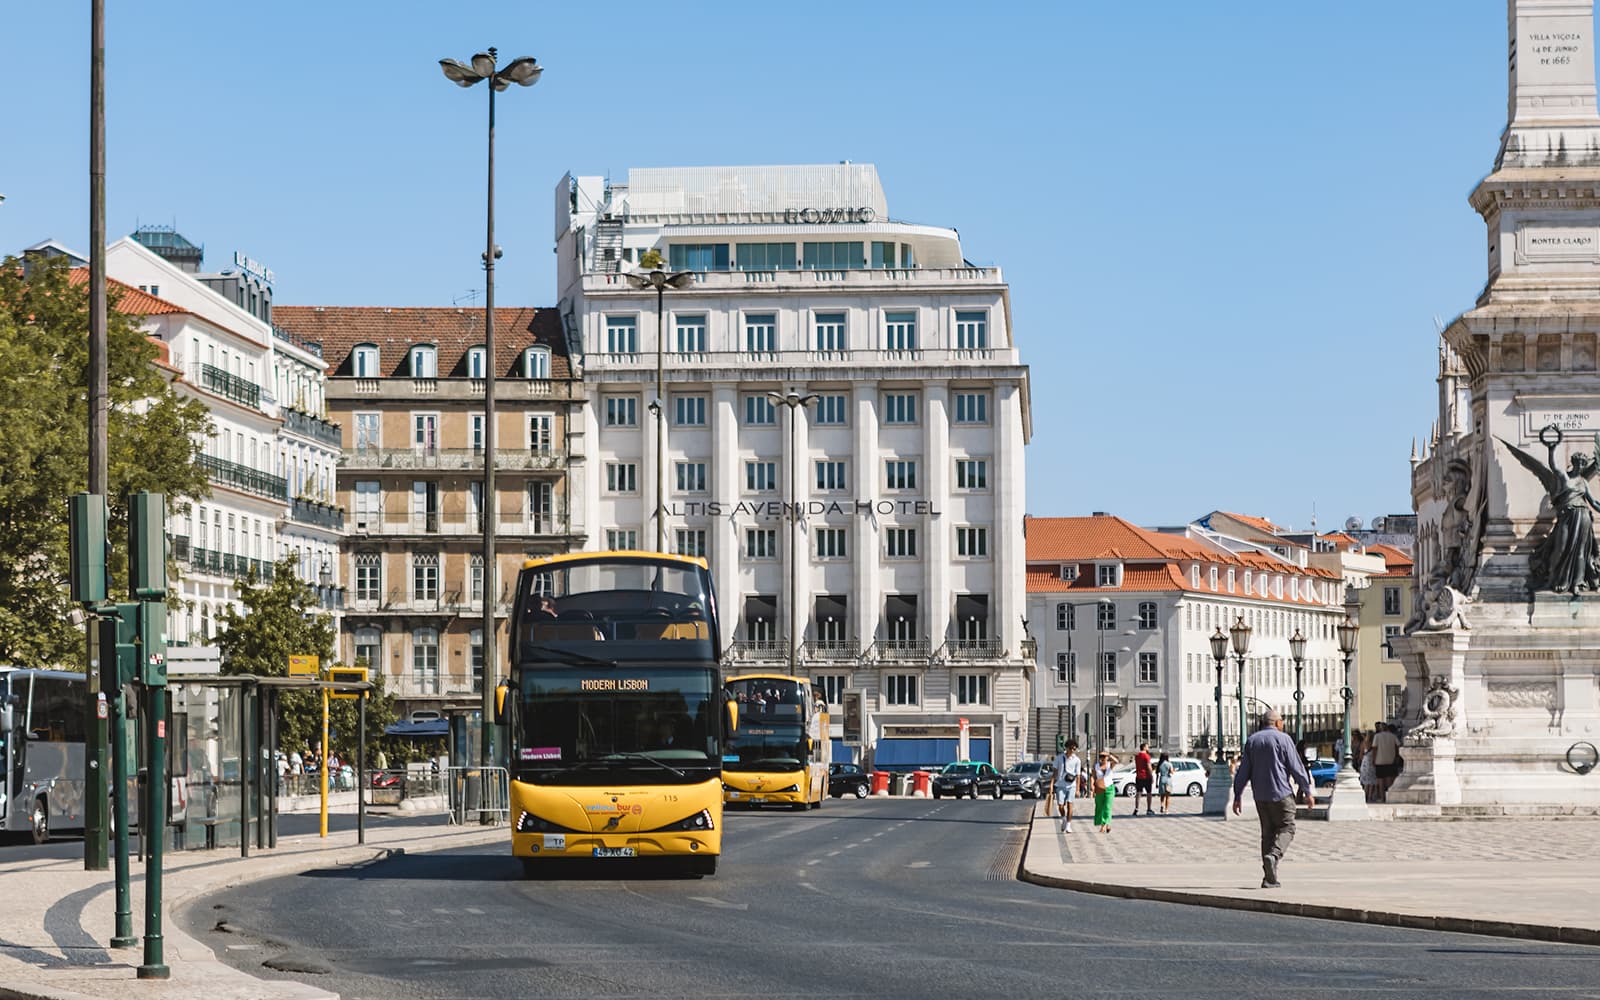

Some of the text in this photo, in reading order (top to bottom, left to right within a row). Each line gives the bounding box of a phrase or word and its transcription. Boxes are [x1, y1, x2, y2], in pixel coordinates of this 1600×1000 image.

[731, 501, 844, 516] AVENIDA
[855, 500, 942, 515] HOTEL
[581, 679, 649, 690] MODERN LISBON
[553, 838, 565, 846] TP
